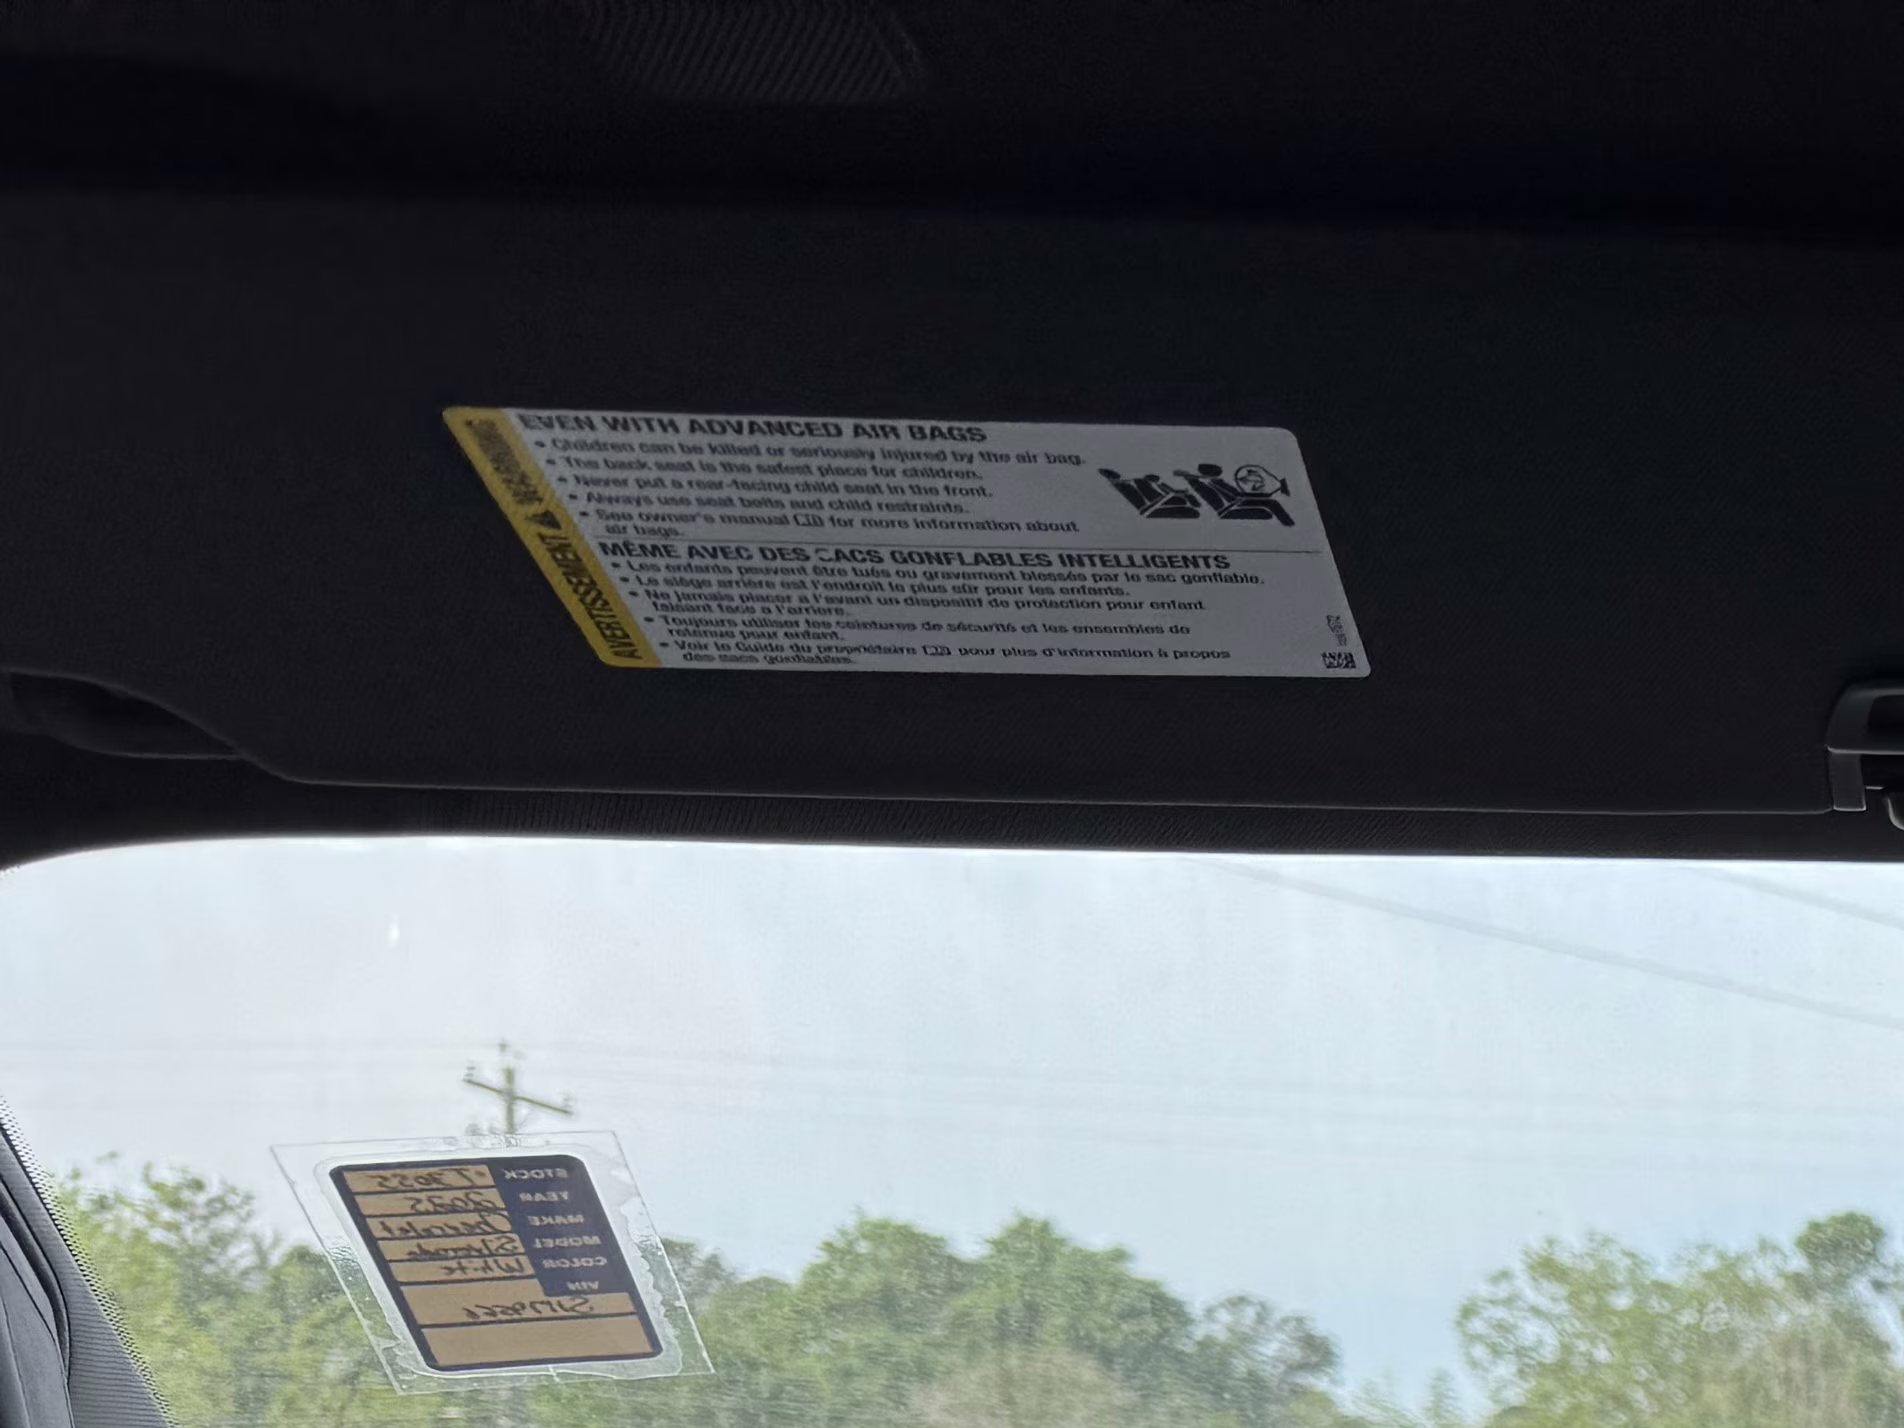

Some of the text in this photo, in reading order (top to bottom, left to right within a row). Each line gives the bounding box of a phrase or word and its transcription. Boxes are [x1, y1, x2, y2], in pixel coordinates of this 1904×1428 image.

[602, 416, 680, 435] WITH
[688, 417, 842, 438] ADVANCED
[852, 424, 900, 440] AIR
[908, 426, 987, 442] BAGS
[599, 540, 681, 559] MÊME
[688, 546, 753, 561] AVEC
[760, 547, 811, 562] DES
[890, 550, 1052, 567] GONFLABLES
[1059, 554, 1231, 569] INTELLIGENTS
